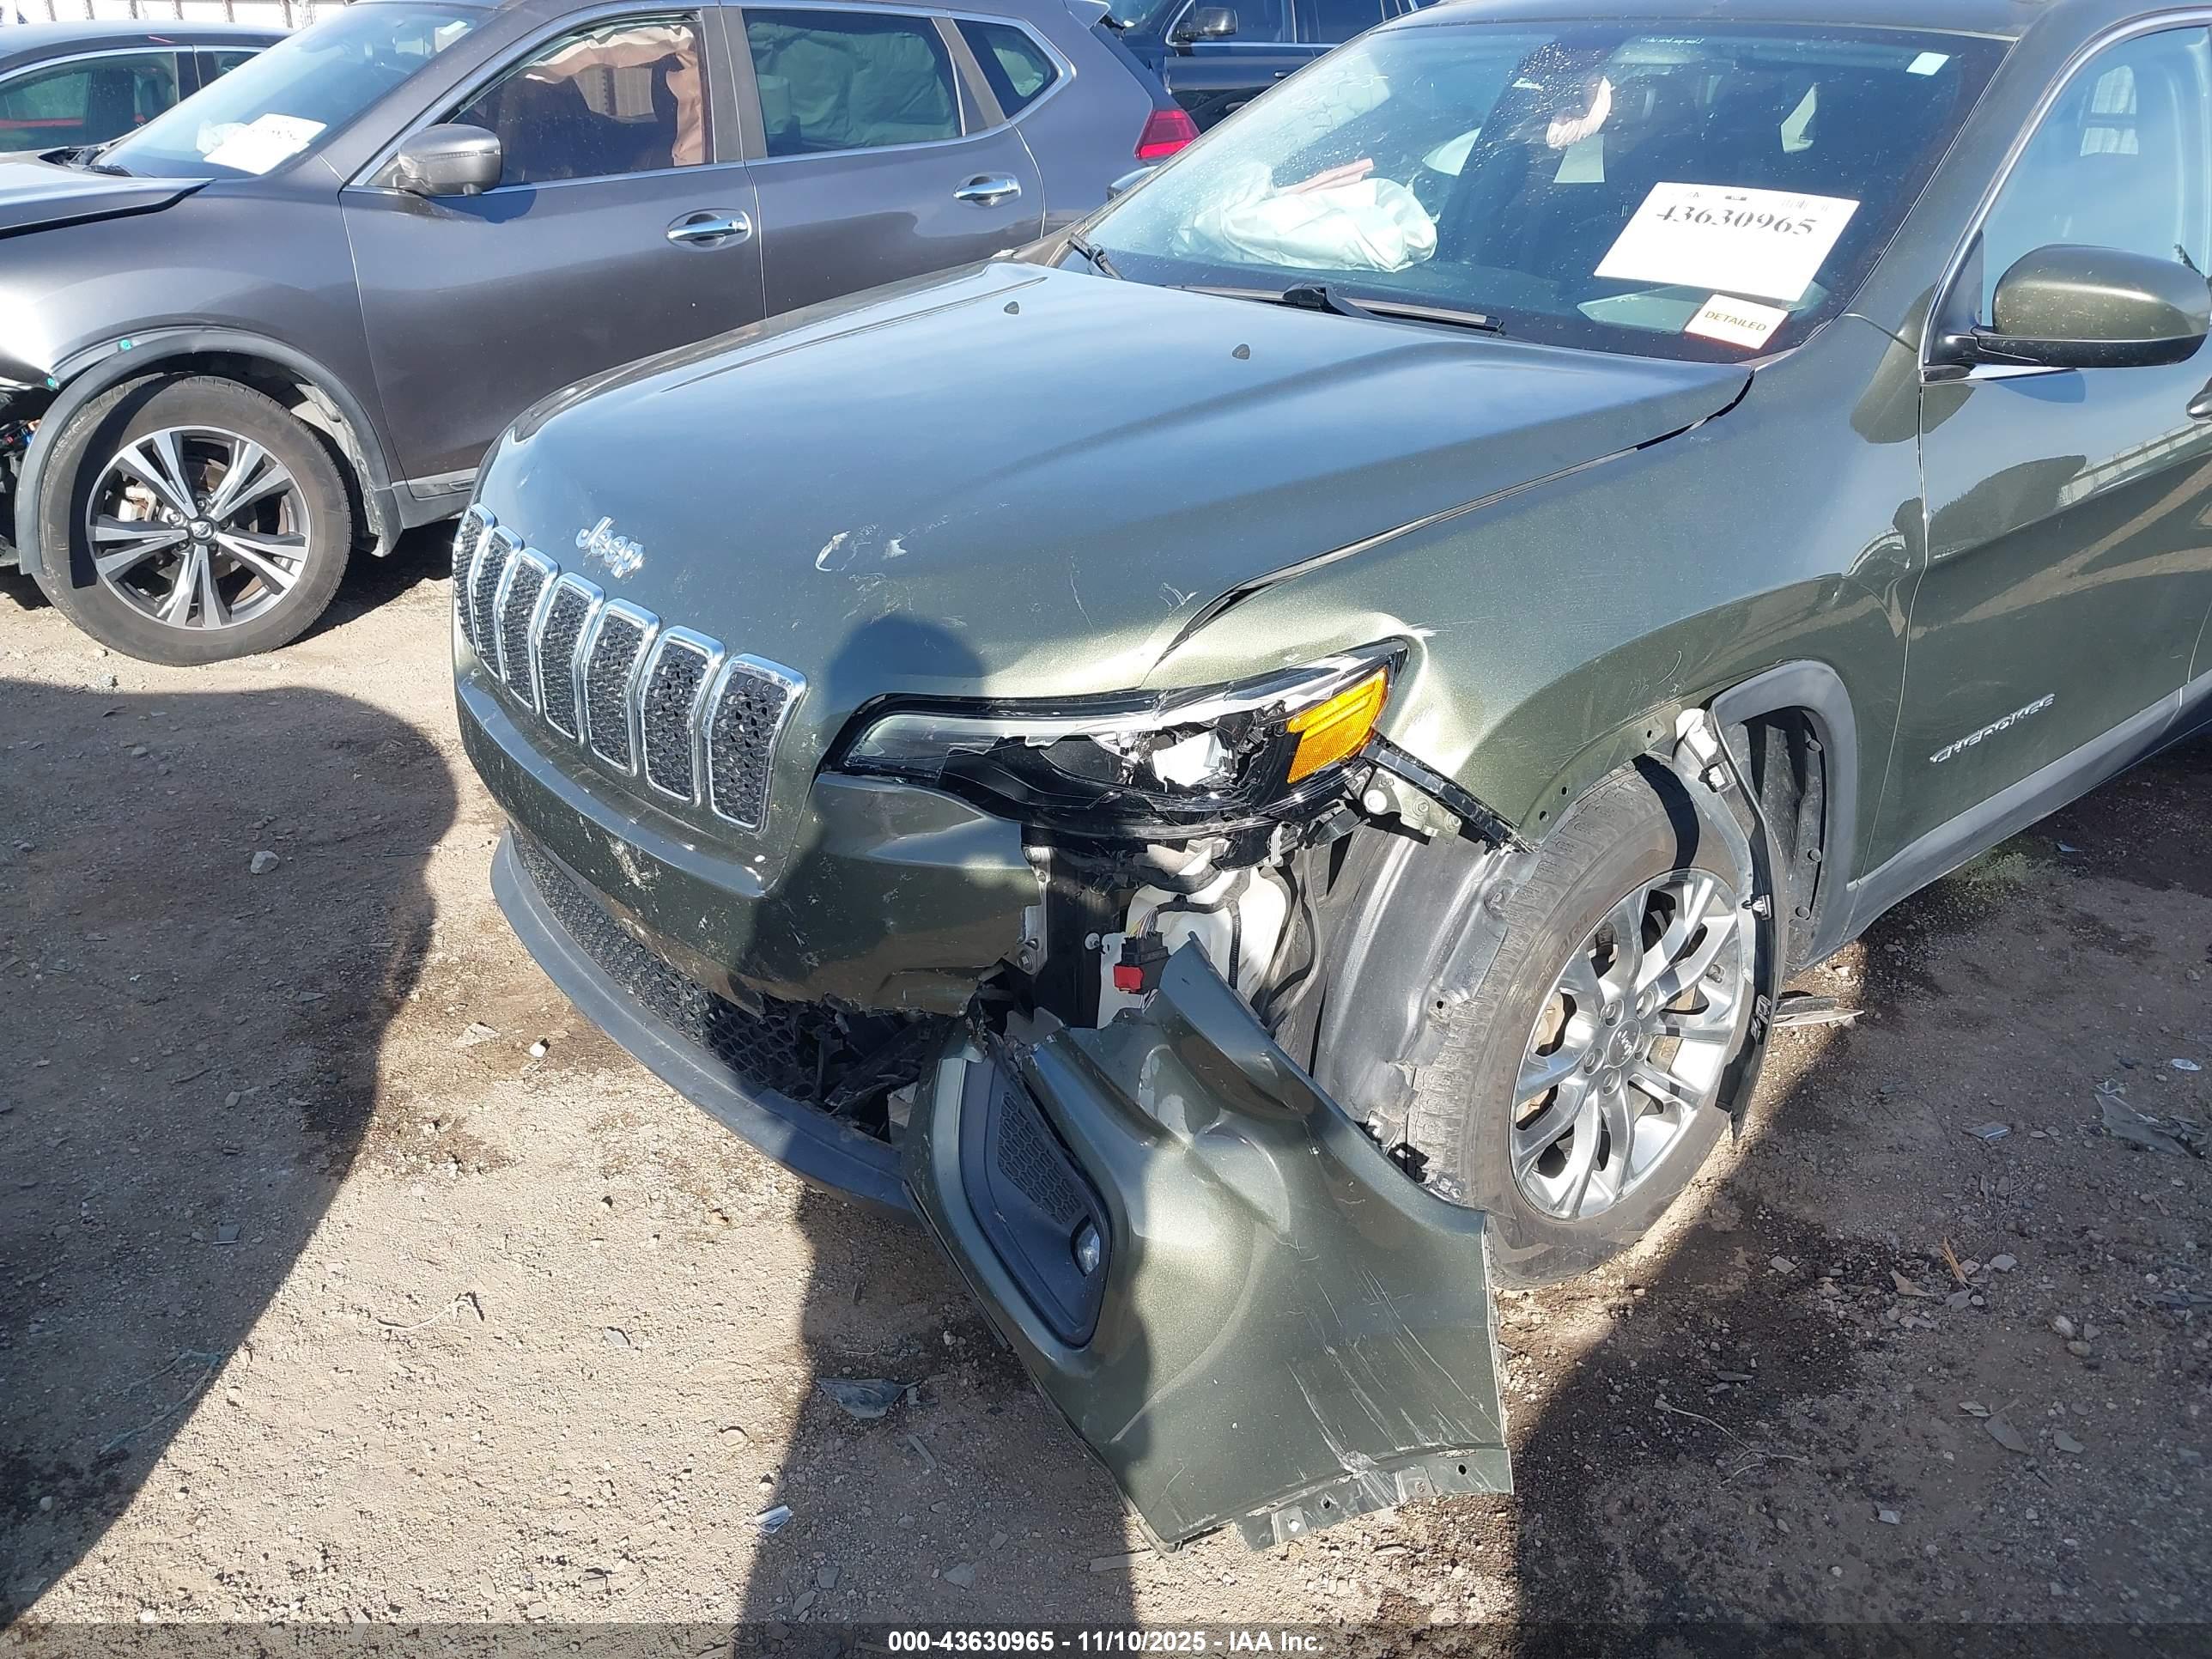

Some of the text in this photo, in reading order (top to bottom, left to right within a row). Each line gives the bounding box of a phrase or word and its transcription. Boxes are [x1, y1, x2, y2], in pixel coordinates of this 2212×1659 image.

[1656, 204, 1818, 235] 43630965
[1704, 311, 1767, 331] DETAILED
[575, 515, 646, 579] Jeep
[1929, 693, 2056, 763] CHEROKEE
